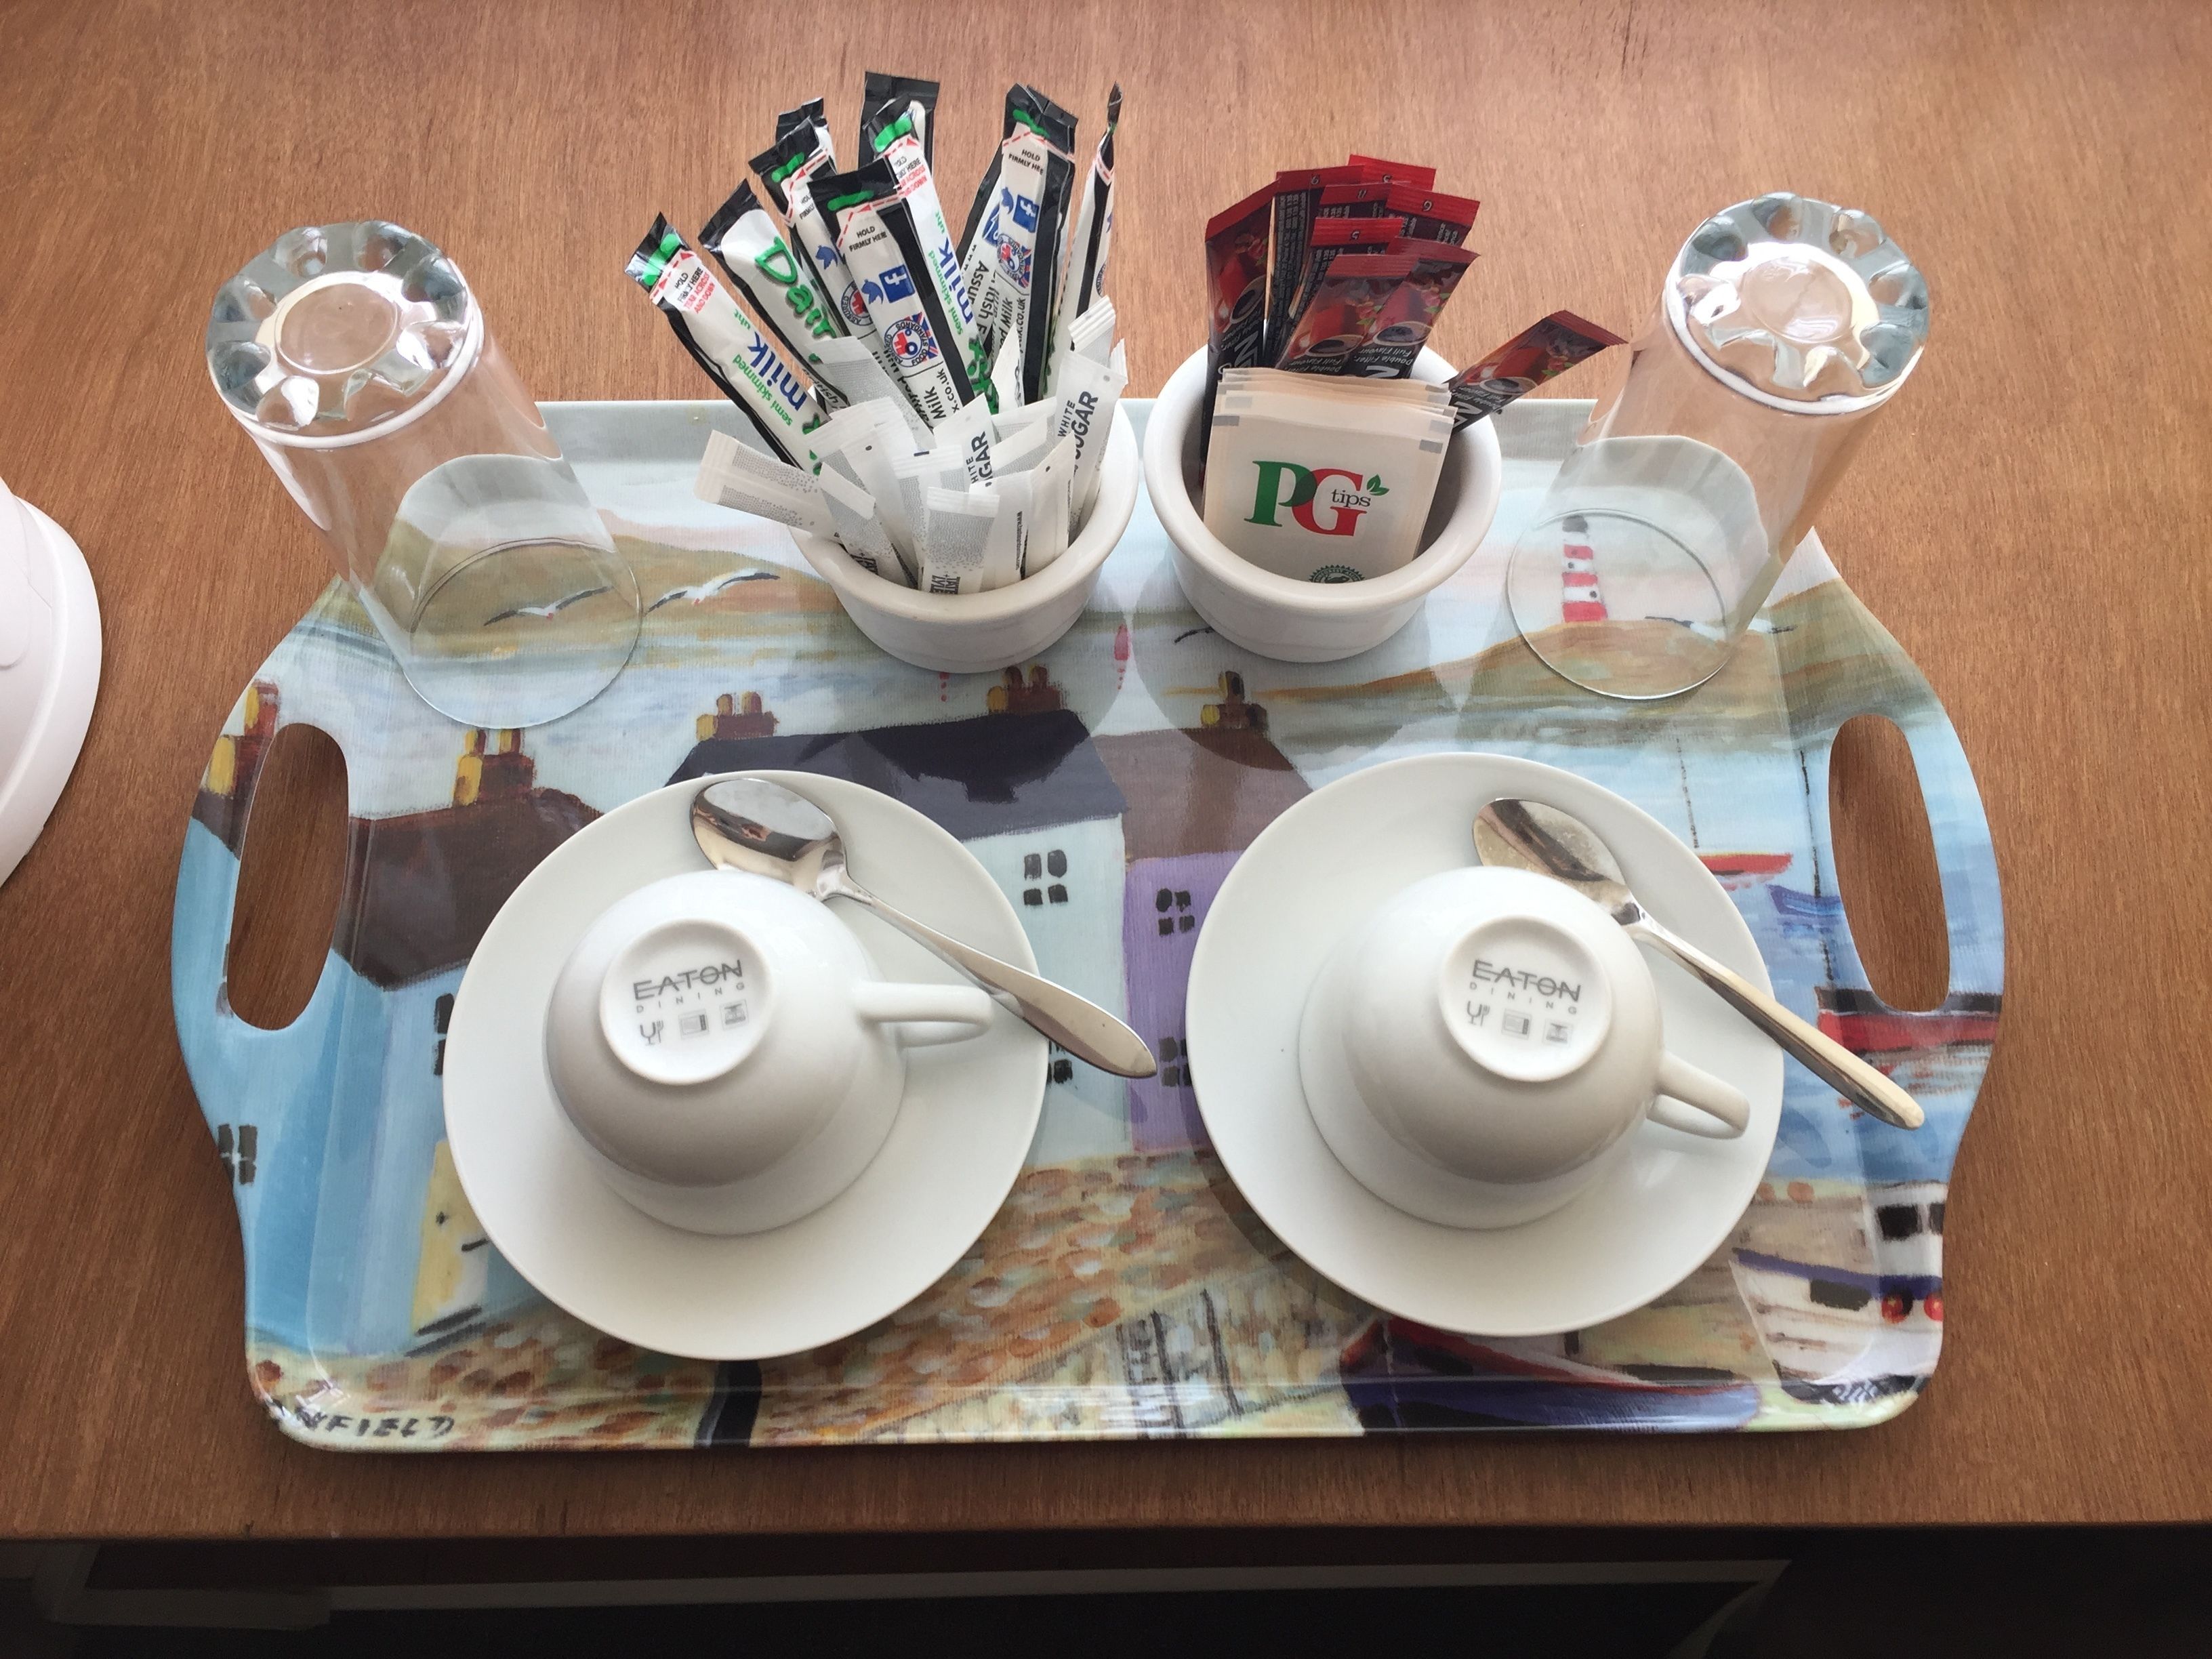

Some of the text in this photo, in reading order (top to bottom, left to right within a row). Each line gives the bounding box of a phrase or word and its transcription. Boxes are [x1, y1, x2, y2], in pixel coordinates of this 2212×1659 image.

[1008, 154, 1031, 167] FIRMLY
[1021, 149, 1040, 161] HOLD
[856, 226, 876, 239] HOLD
[935, 211, 945, 234] uht
[848, 237, 872, 252] FIRMLY
[689, 266, 703, 285] HERE
[939, 237, 974, 324] milk
[968, 260, 989, 305] Assur
[928, 250, 964, 335] semi skimmed
[734, 308, 751, 330] uht
[911, 348, 927, 367] FOOD
[1359, 347, 1413, 356] Full Flavour
[1382, 356, 1413, 366] Double
[747, 331, 808, 411] milk
[733, 354, 793, 426] semi skimmed
[924, 386, 947, 419] Milk
[1057, 400, 1076, 437] WHITE
[966, 456, 979, 484] HITE
[970, 431, 994, 485] GAR
[1244, 460, 1371, 536] PG tips
[634, 960, 742, 1000] EATON
[1473, 960, 1581, 1002] EATON
[636, 982, 745, 1013] DINING
[1469, 982, 1578, 1015] DINING
